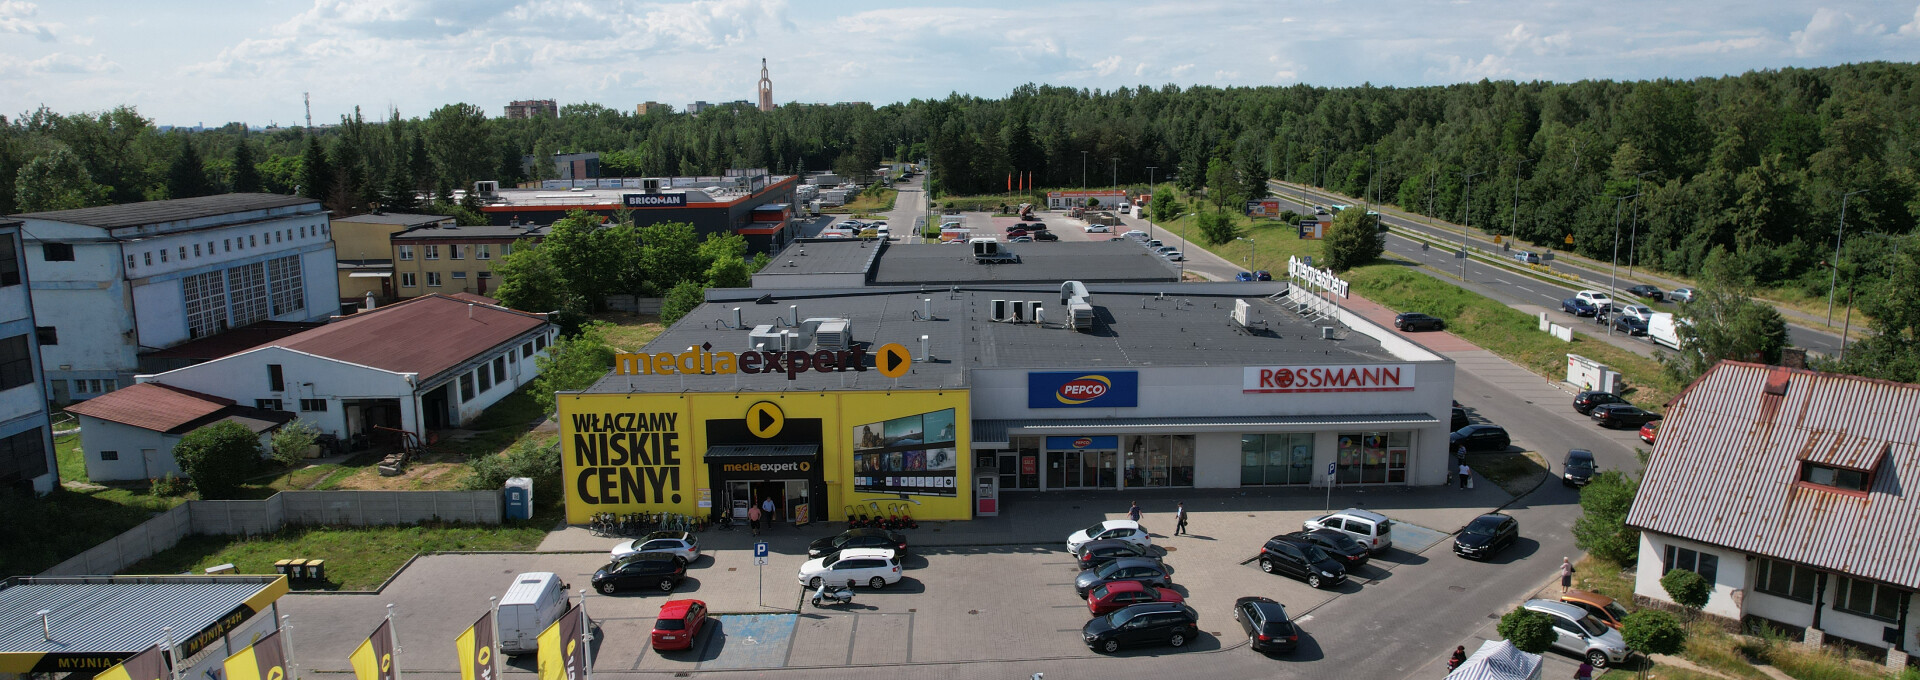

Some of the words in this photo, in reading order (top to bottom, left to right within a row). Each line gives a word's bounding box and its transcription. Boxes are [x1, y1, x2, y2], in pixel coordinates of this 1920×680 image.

[629, 196, 680, 205] BRICOMAN
[616, 342, 868, 380] mediaexpert
[1260, 367, 1400, 388] ROSSMANN
[1064, 385, 1103, 395] PEPCO
[572, 412, 678, 434] WŁĄCZAMY
[574, 433, 681, 466] NISKIE
[723, 461, 798, 473] mediaexpert
[577, 467, 682, 504] CENY!
[757, 544, 766, 555] P
[190, 624, 224, 653] MYJNIA
[225, 611, 242, 629] 24H
[58, 657, 112, 669] MYJNIA
